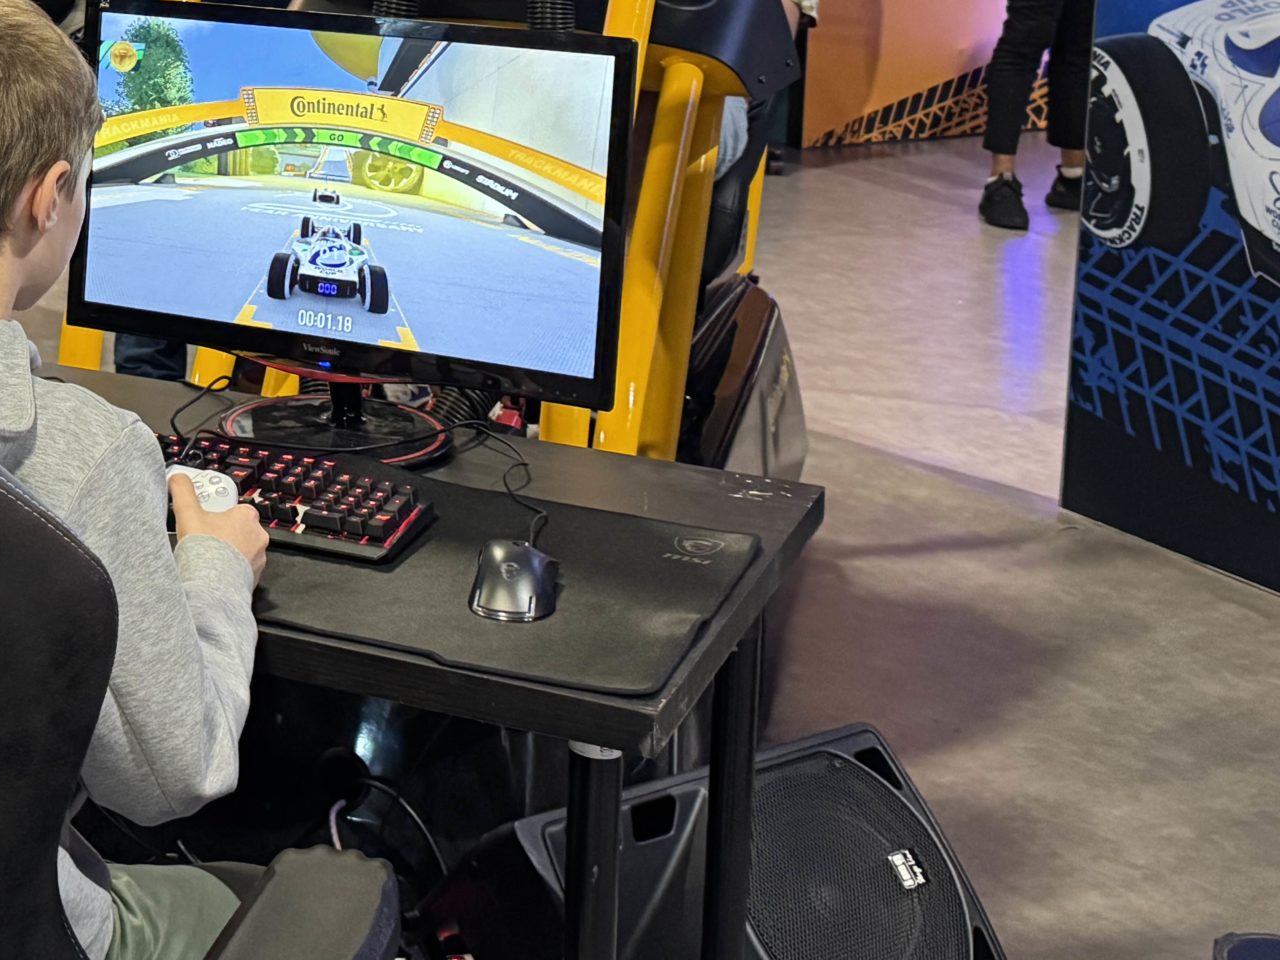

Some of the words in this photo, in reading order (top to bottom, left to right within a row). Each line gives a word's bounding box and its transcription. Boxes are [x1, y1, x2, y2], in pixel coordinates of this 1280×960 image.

[290, 95, 375, 120] Continental
[329, 133, 344, 142] GO
[298, 309, 352, 333] 00:01.18
[303, 342, 340, 356] ViewSonic
